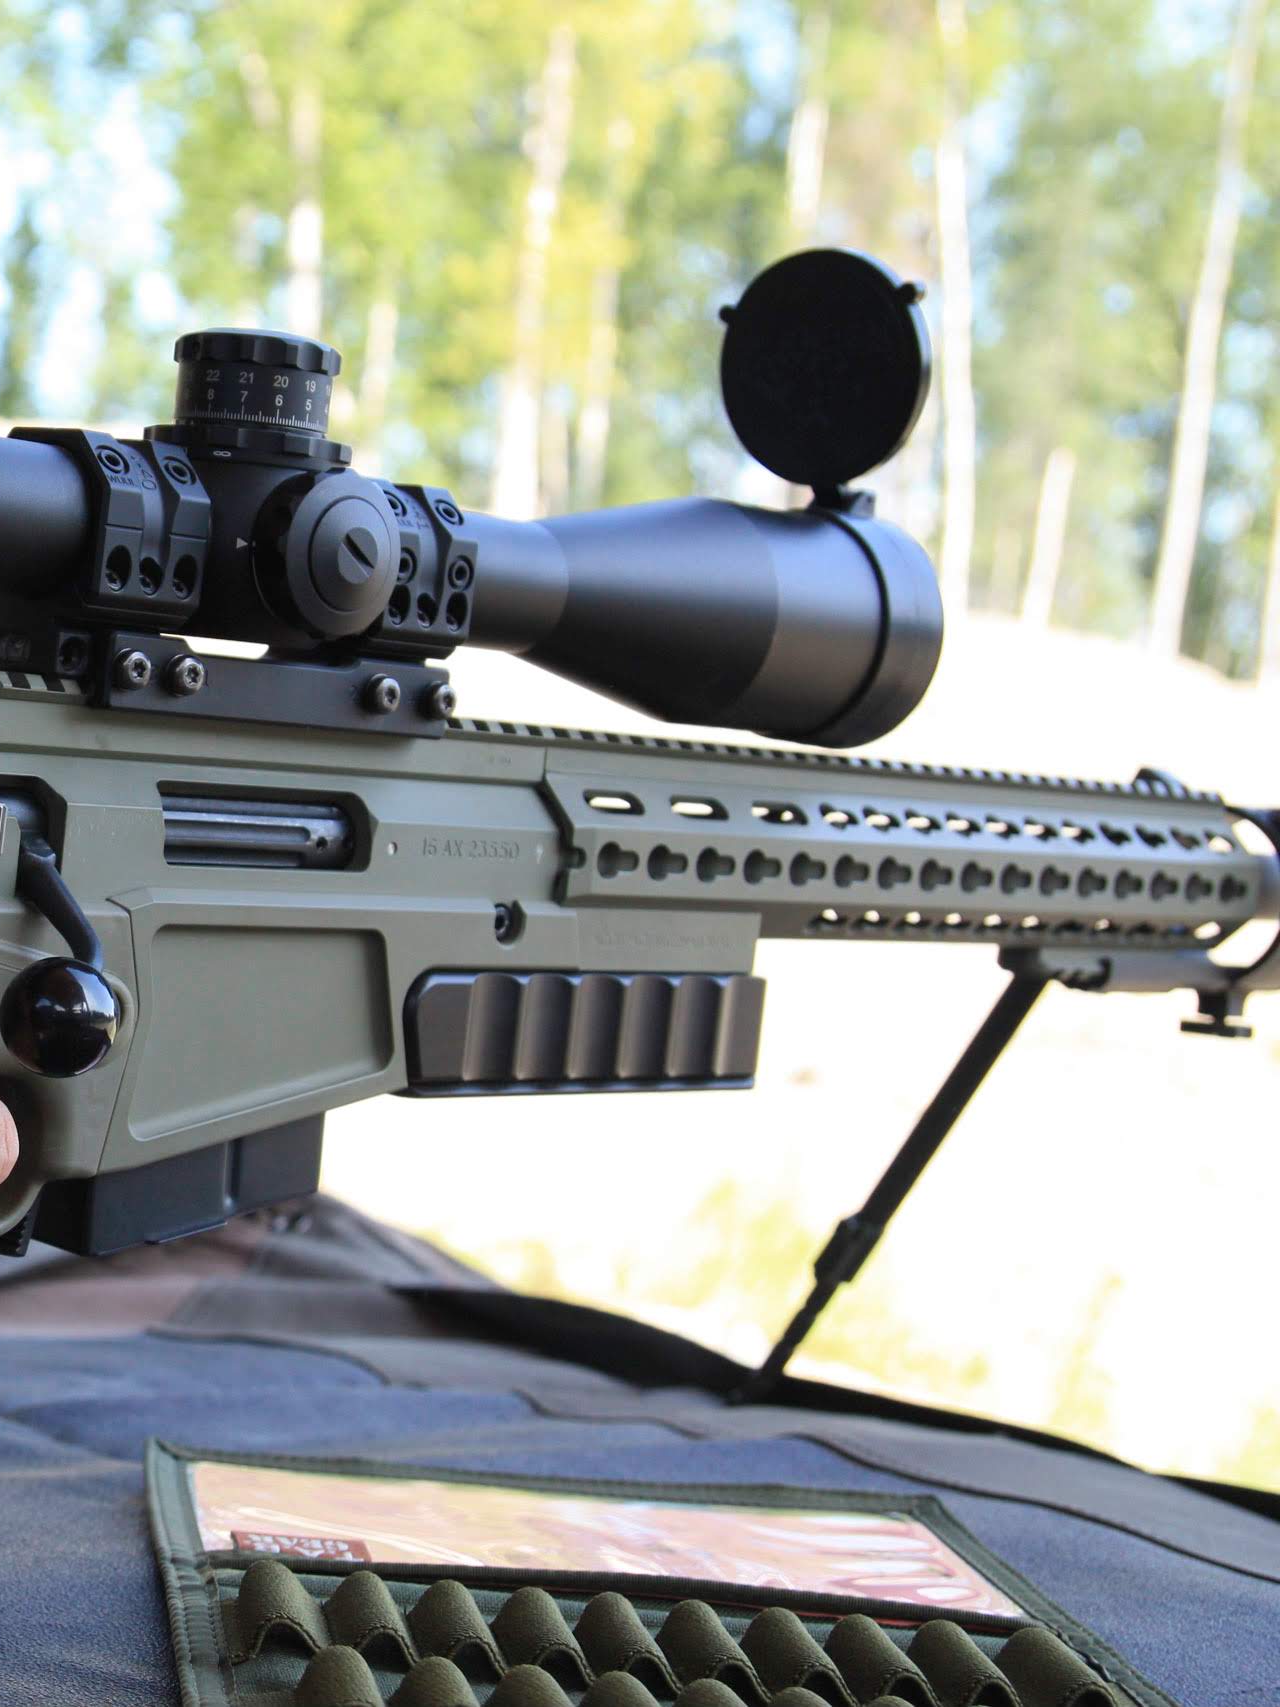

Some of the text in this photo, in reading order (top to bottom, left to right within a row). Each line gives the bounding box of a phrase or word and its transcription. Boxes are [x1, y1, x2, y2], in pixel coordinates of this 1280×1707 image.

[206, 369, 220, 381] 22
[239, 371, 254, 384] 21
[272, 375, 289, 388] 20
[305, 380, 317, 393] 19
[207, 388, 215, 400] 8
[240, 390, 249, 402] 7
[275, 394, 283, 406] 6
[305, 399, 312, 411] 5
[442, 840, 463, 857] AX
